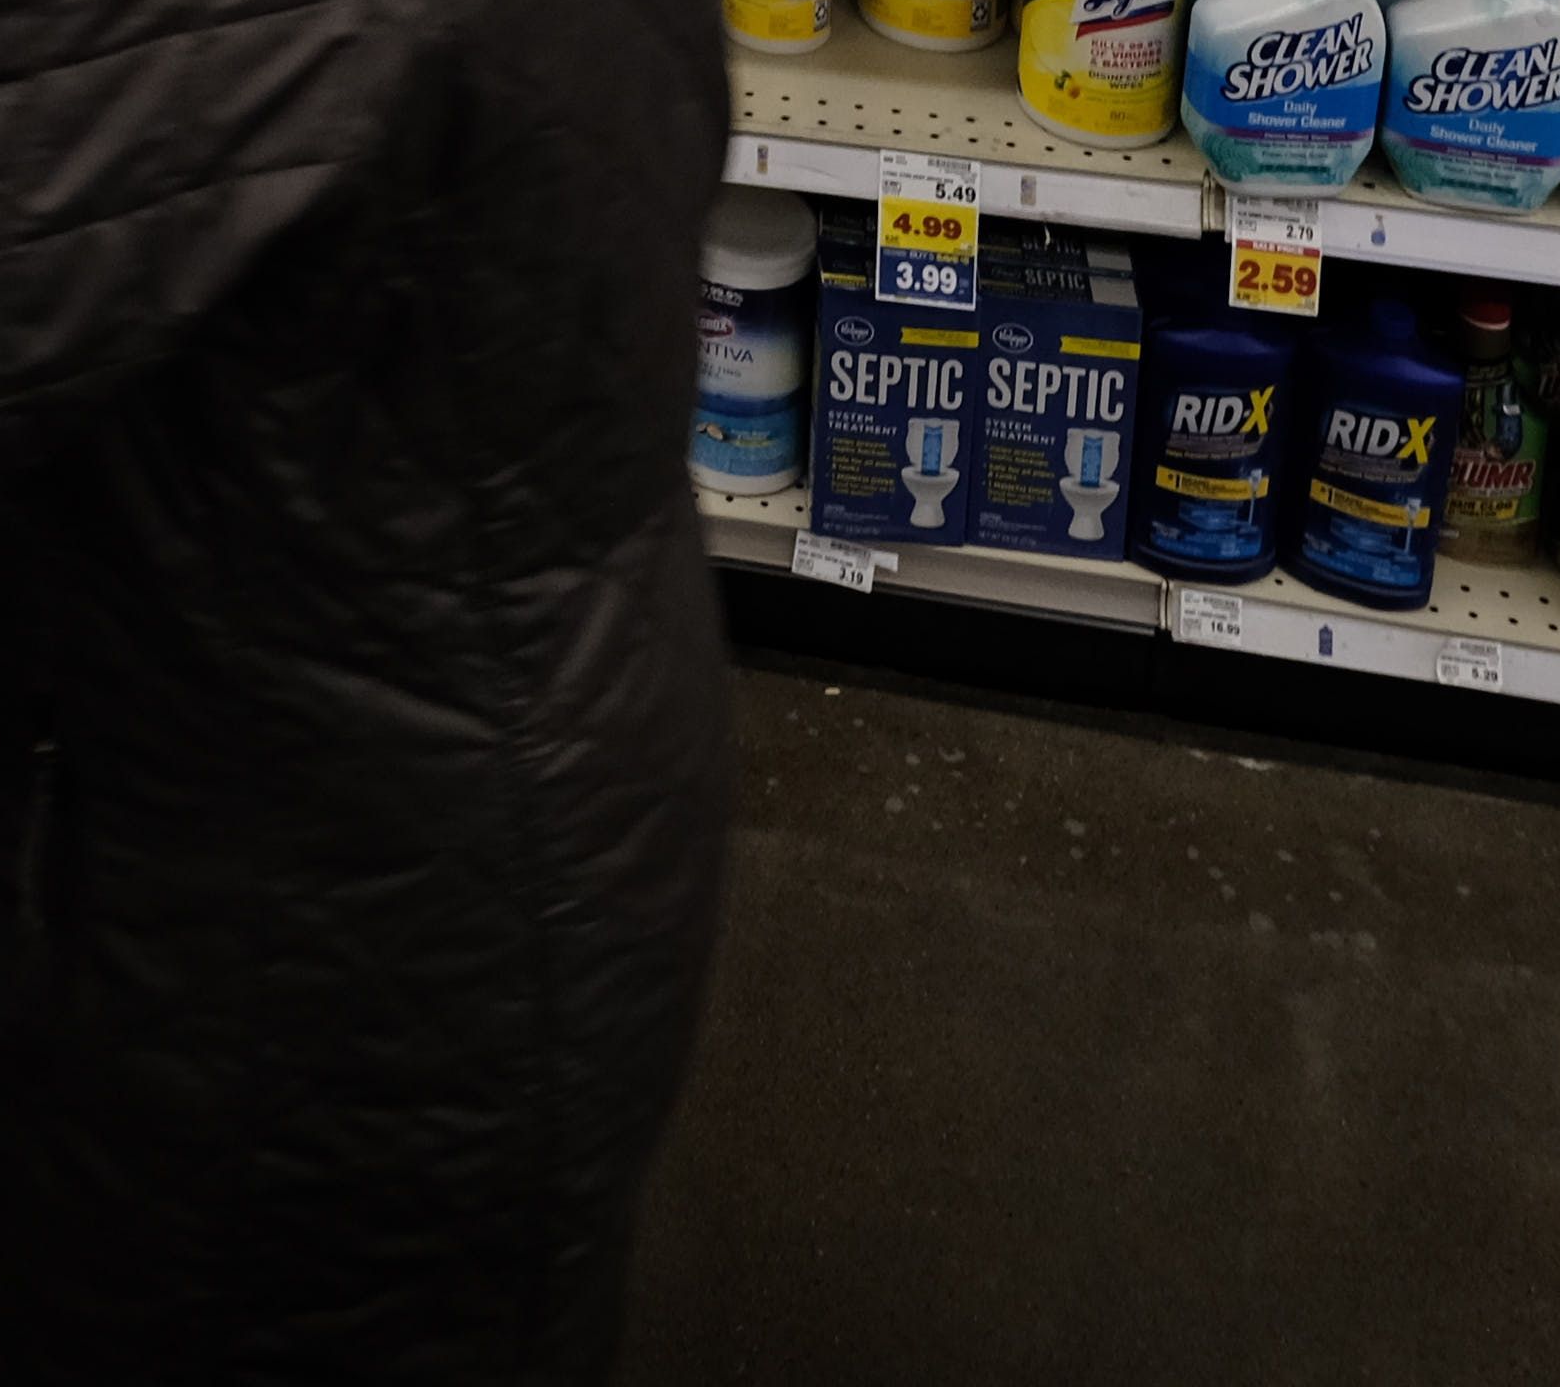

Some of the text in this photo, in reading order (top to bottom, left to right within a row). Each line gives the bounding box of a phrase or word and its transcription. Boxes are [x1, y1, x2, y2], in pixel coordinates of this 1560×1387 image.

[1223, 43, 1373, 101] SHOWER
[1284, 100, 1317, 117] Daily
[1430, 125, 1538, 153] Shower Cleaner
[1469, 118, 1505, 136] Daily
[936, 183, 977, 202] 5.49
[893, 213, 962, 239] 4.99
[1286, 224, 1314, 240] 2.79
[895, 261, 957, 293] 3.99
[1238, 259, 1317, 296] 2.59
[828, 349, 964, 412] SEPTIC
[986, 356, 1125, 422] SEPTIC
[828, 410, 875, 424] SYSTEM
[1173, 384, 1277, 436] RID-X
[985, 428, 1056, 446] TREATMENT
[1327, 408, 1438, 465] RID-X
